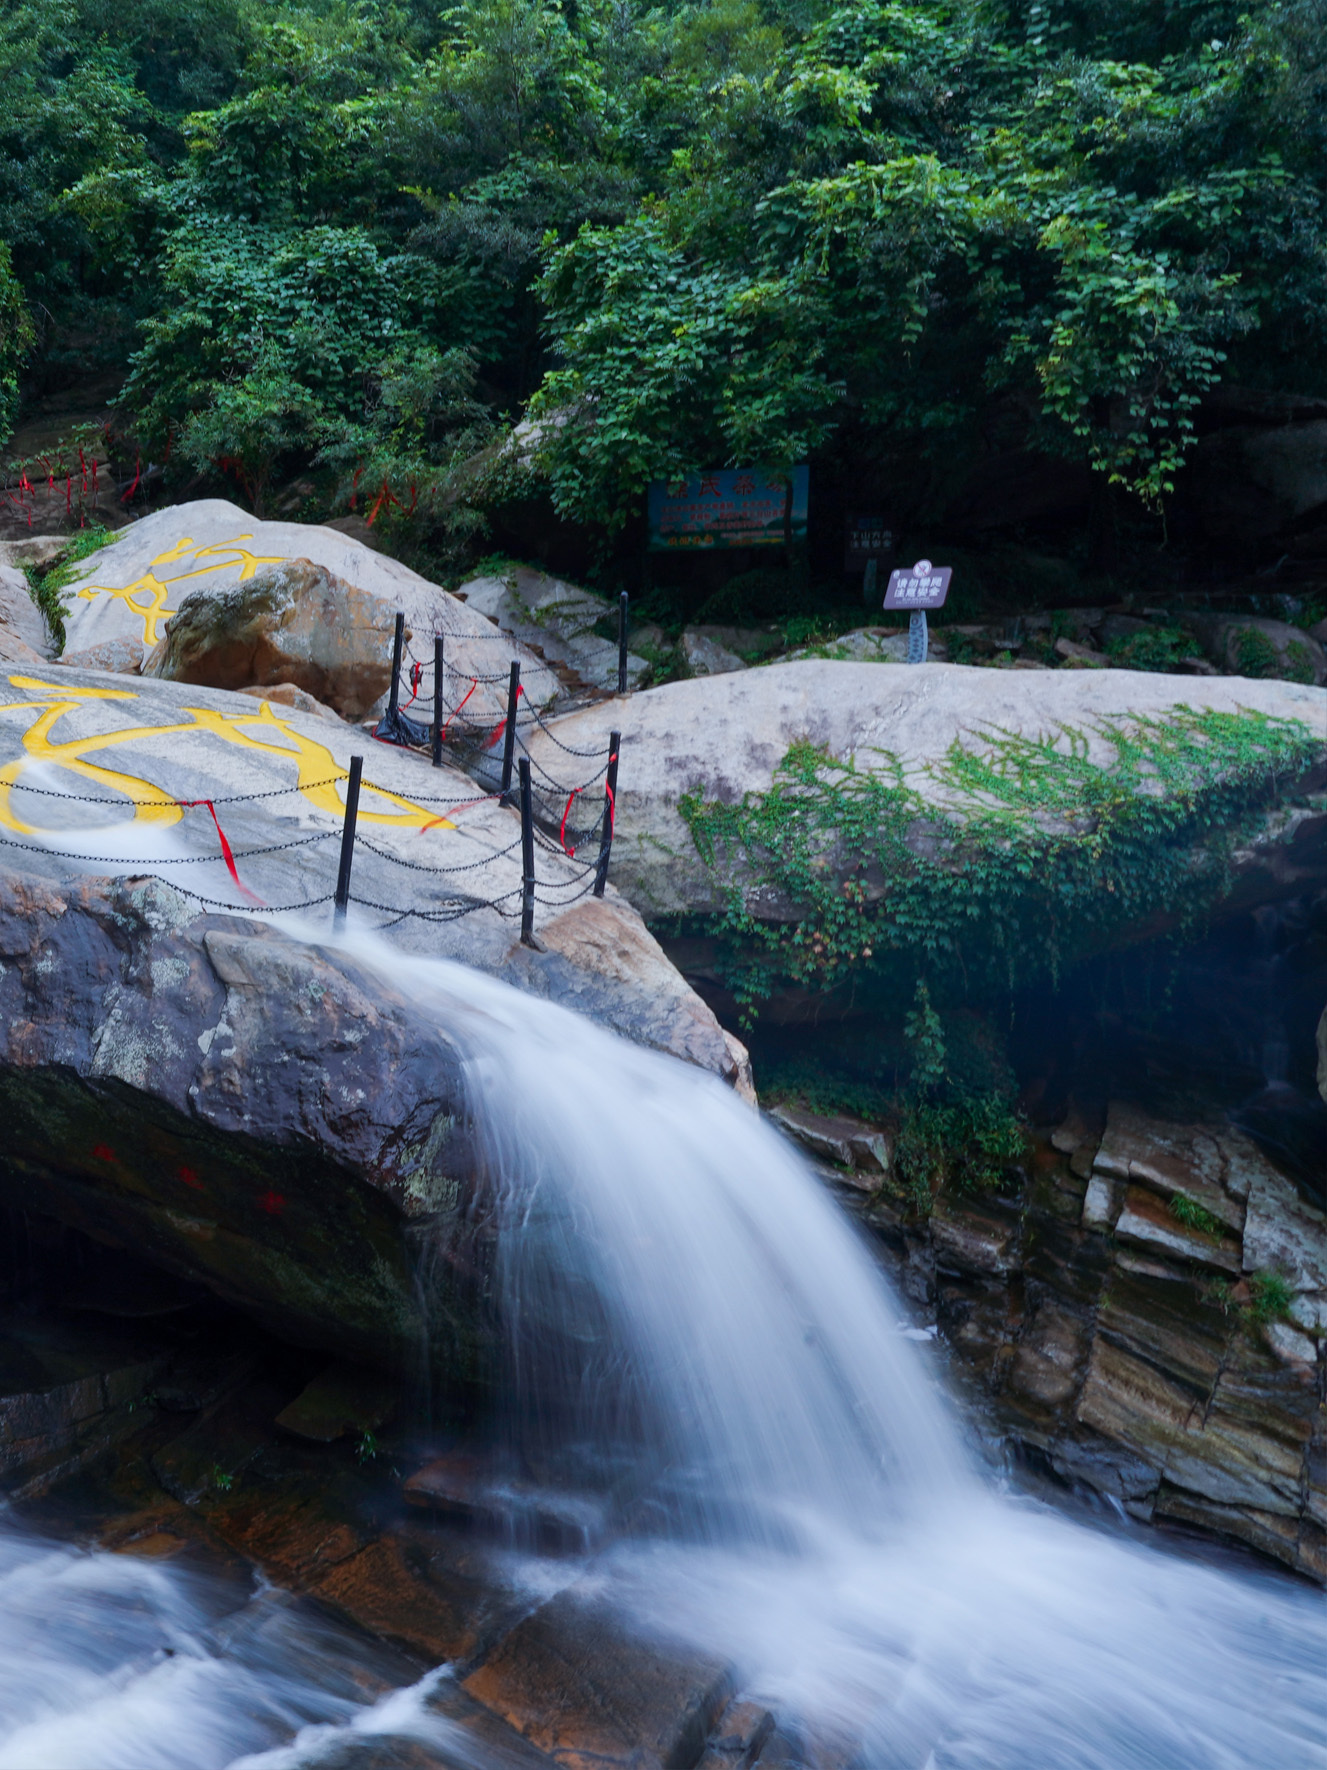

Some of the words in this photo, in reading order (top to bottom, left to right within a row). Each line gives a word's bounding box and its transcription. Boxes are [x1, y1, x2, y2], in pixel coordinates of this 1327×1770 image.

[850, 539, 892, 549] 注意安全
[897, 577, 942, 588] 请勿攀爬
[894, 587, 939, 597] 注意安全
